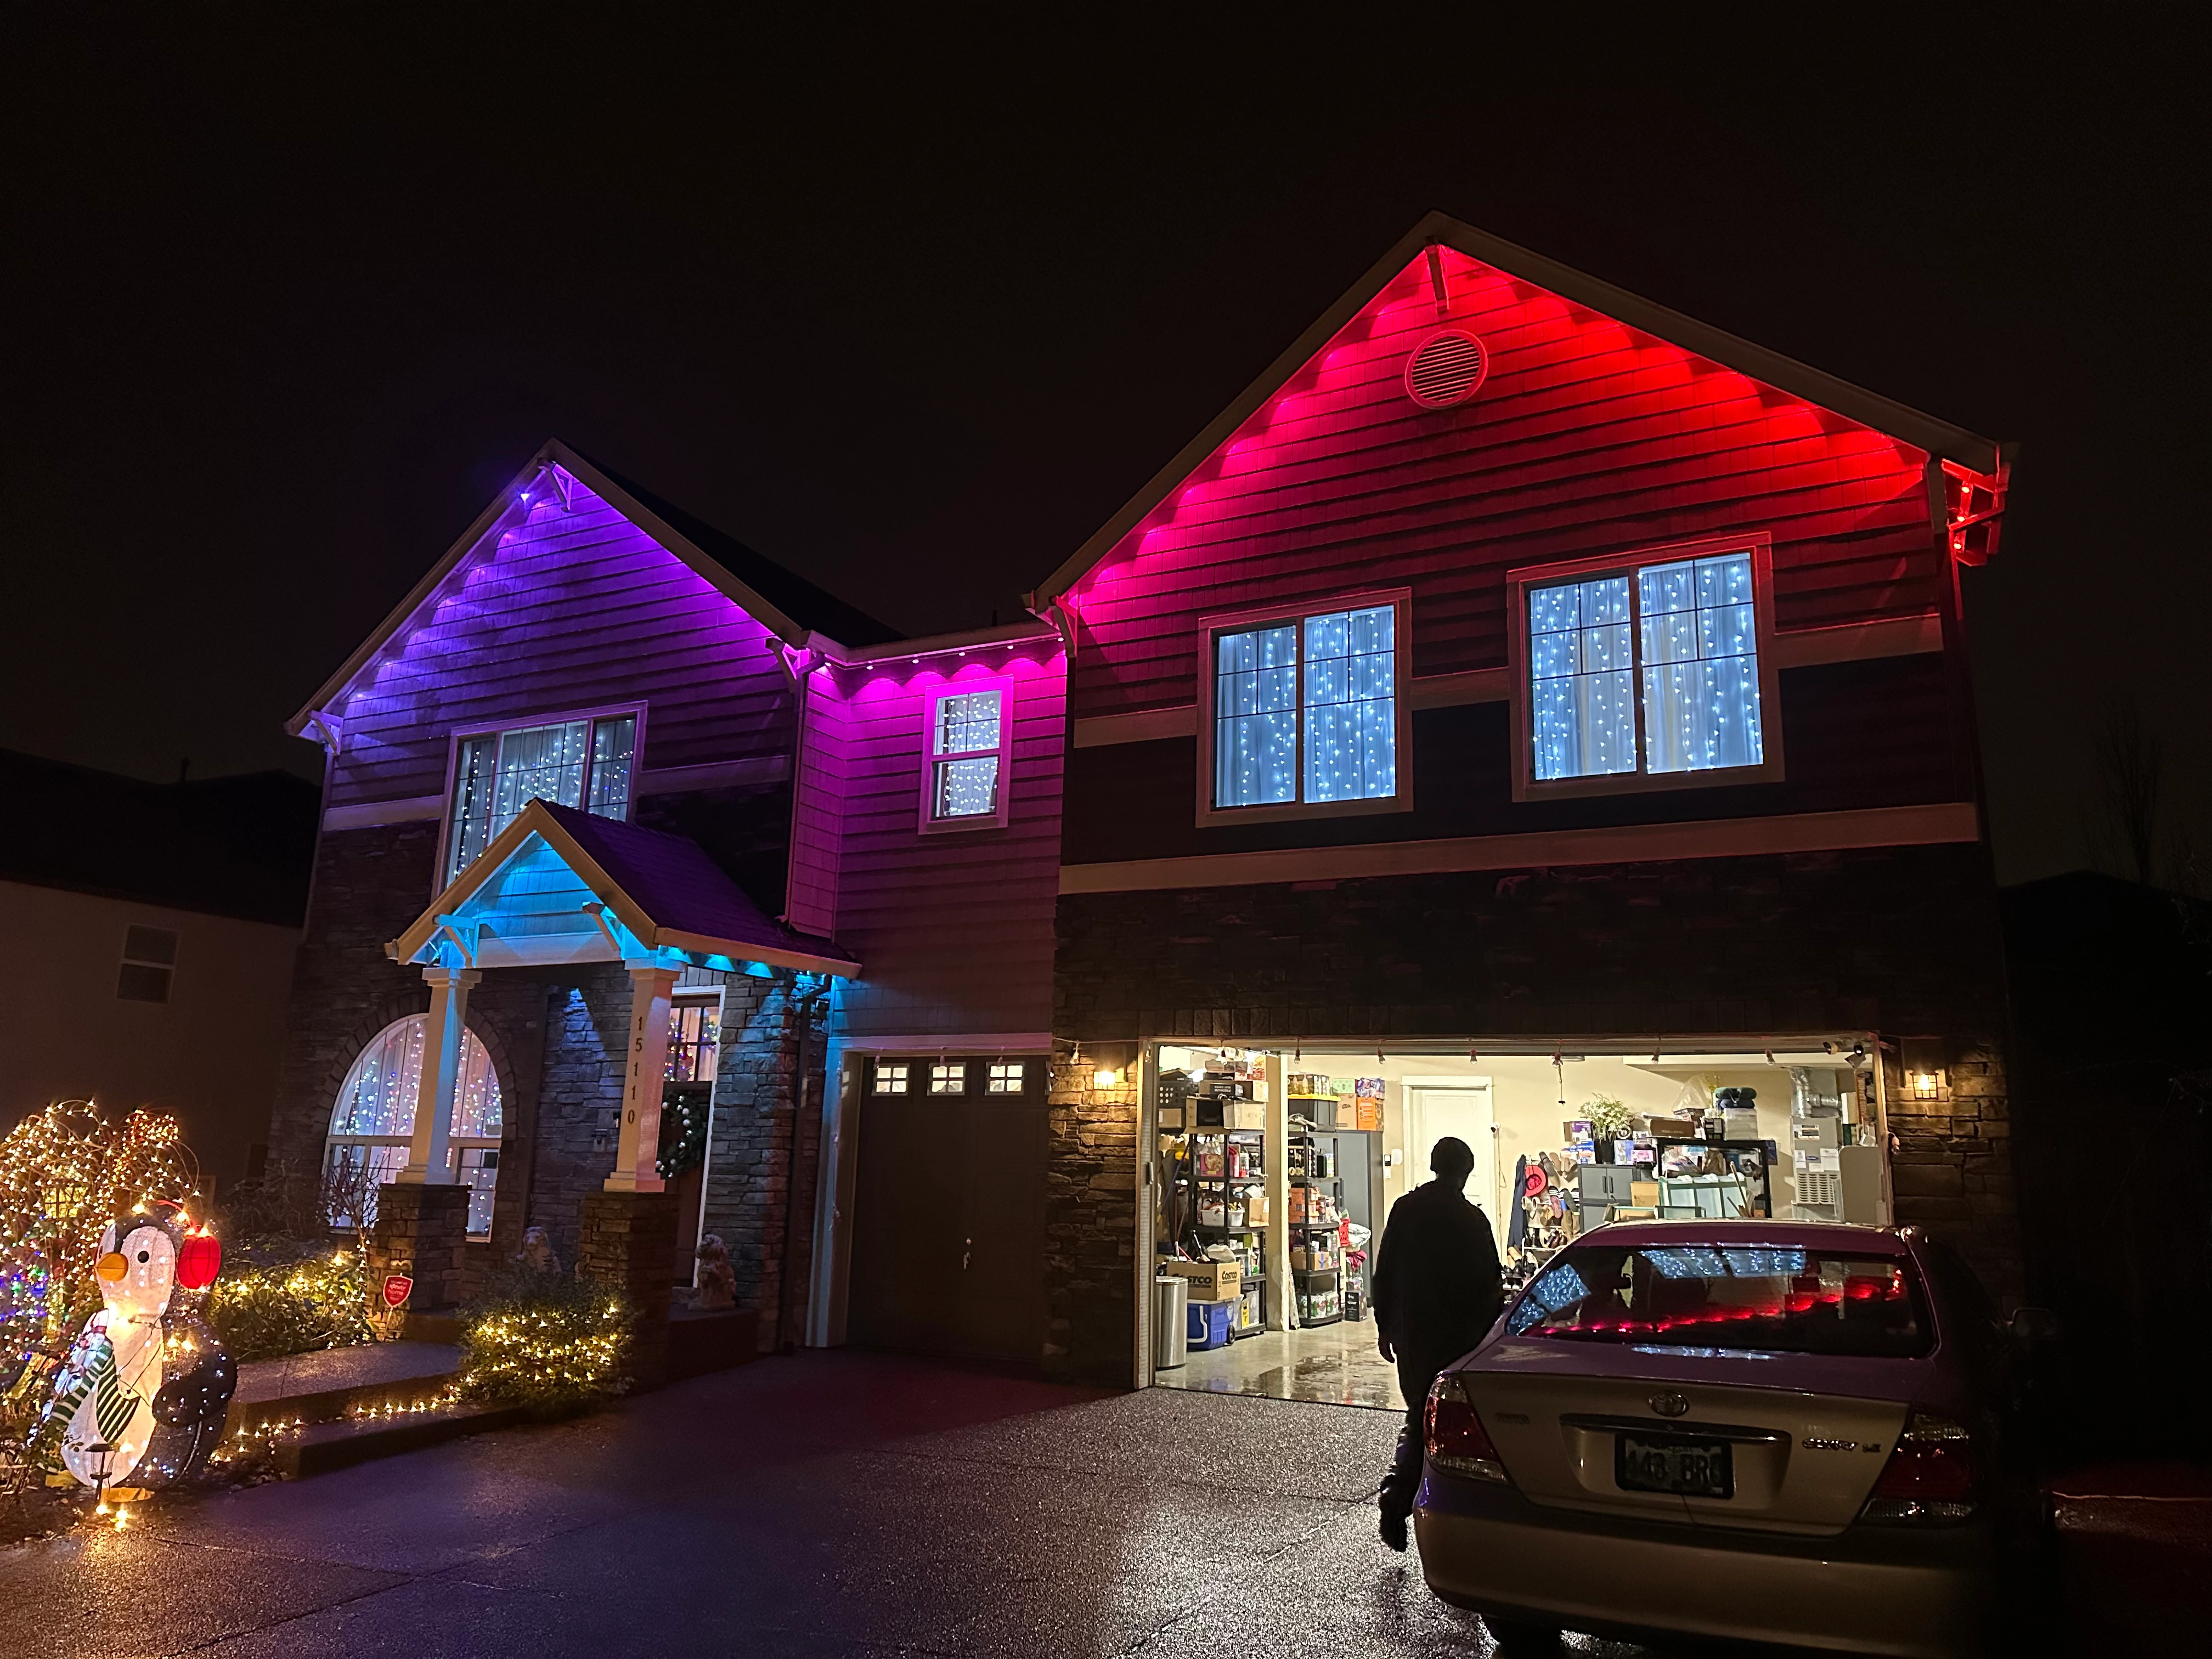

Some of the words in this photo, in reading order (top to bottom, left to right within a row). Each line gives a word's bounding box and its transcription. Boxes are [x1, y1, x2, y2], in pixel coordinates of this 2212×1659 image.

[627, 1017, 643, 1125] 15110
[1172, 1273, 1212, 1284] STCO
[1222, 1271, 1237, 1280] COSTCO
